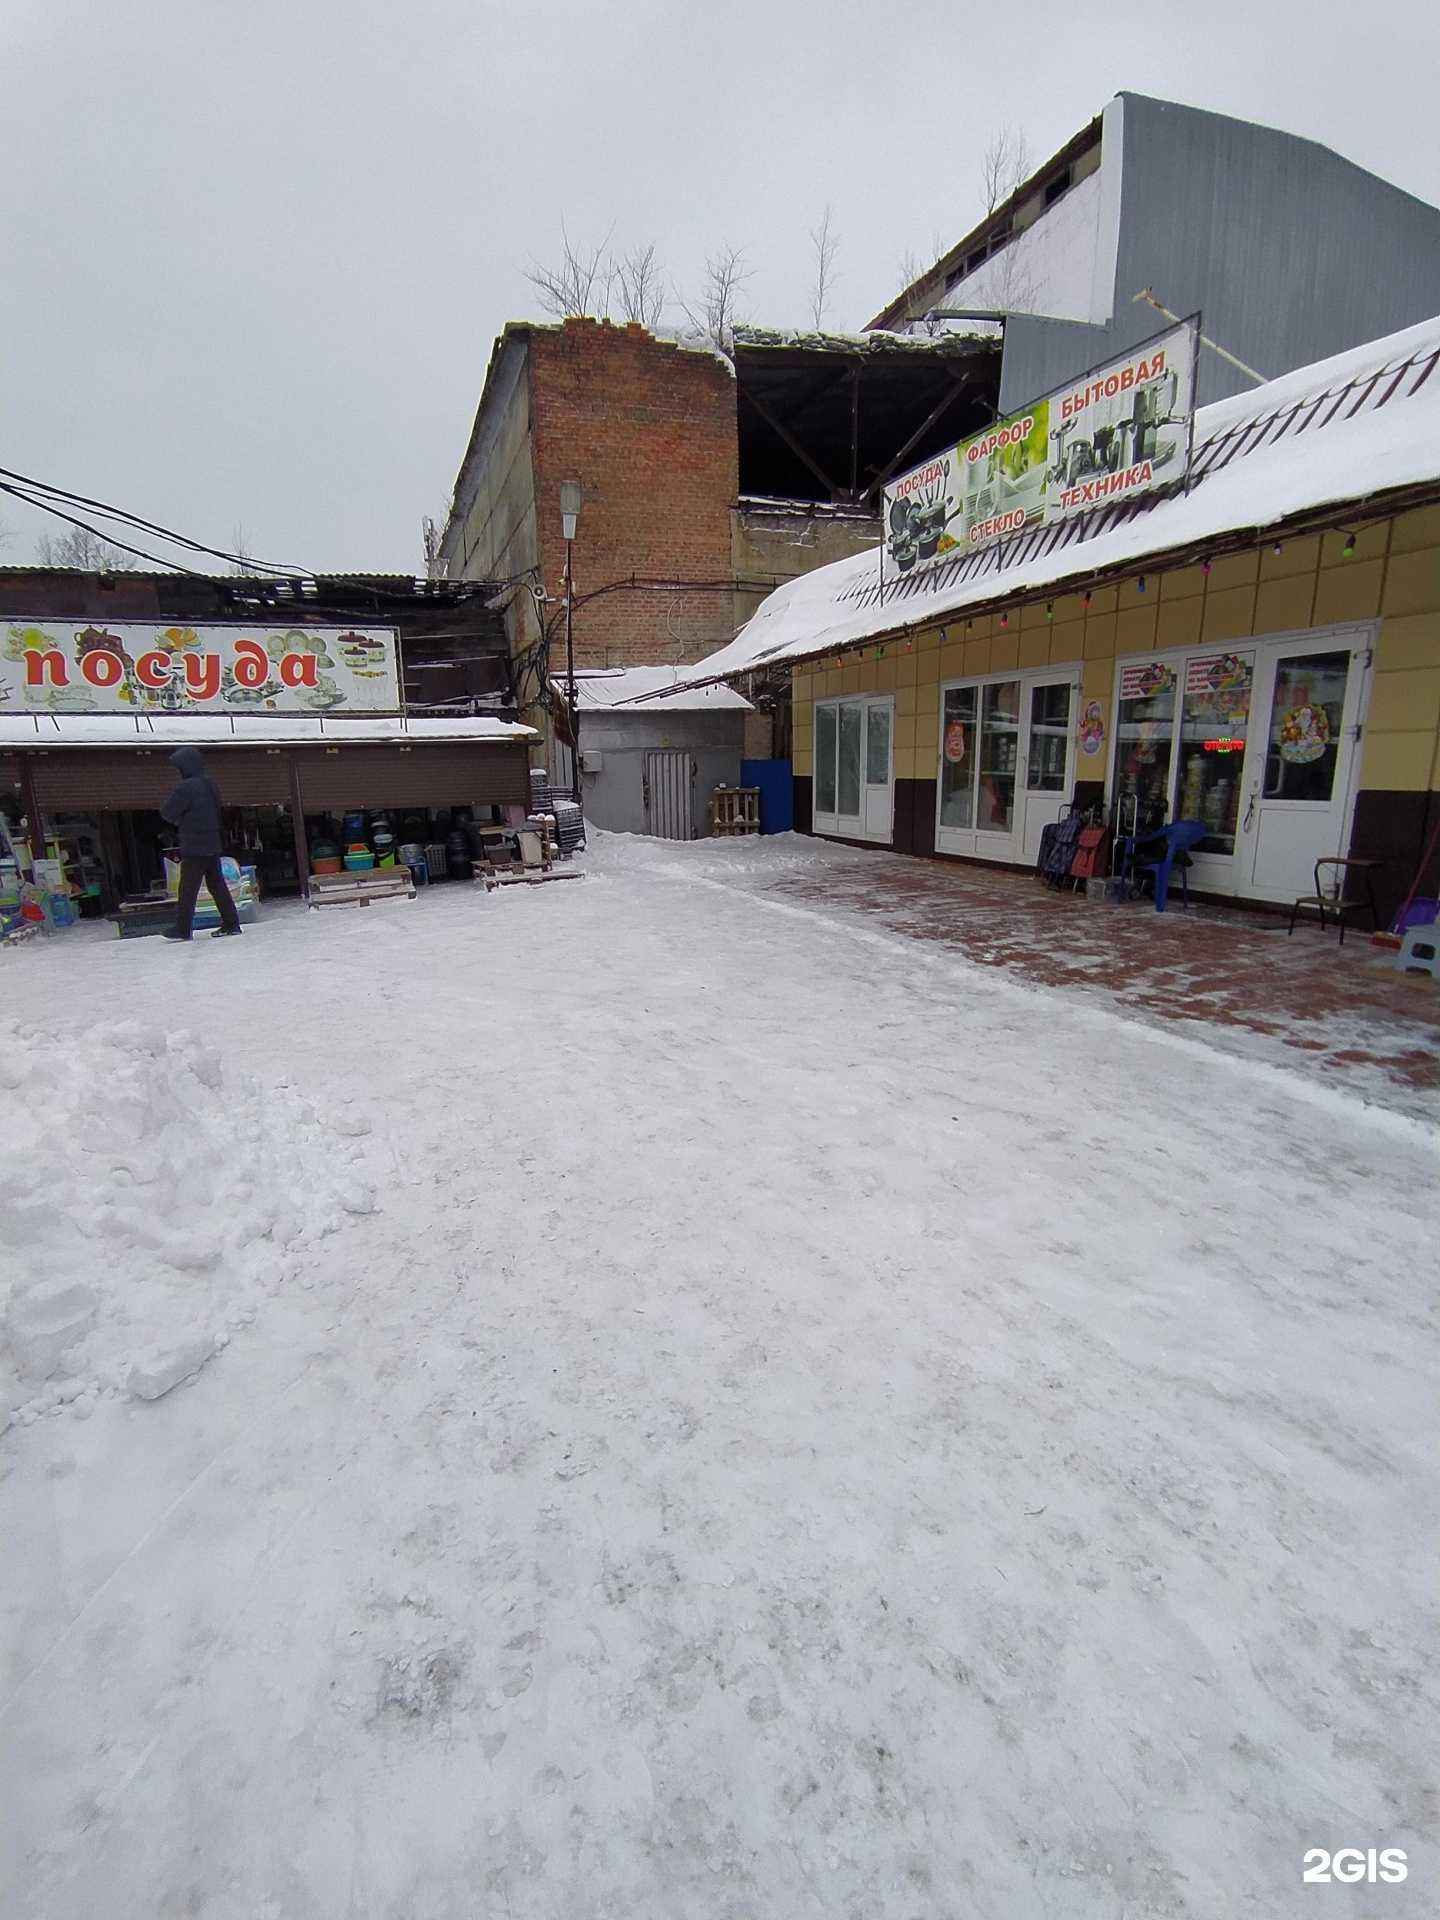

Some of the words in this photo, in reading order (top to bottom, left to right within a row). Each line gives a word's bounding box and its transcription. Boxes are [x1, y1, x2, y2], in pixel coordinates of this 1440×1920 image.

[1060, 350, 1167, 419] БЫТОВАЯ
[967, 417, 1034, 462] ФАРФОР
[896, 464, 944, 497] ПОСУДА
[1059, 459, 1153, 509] ТЕХНИКА
[969, 508, 1026, 543] СТЕКЛО
[23, 638, 320, 700] посуда
